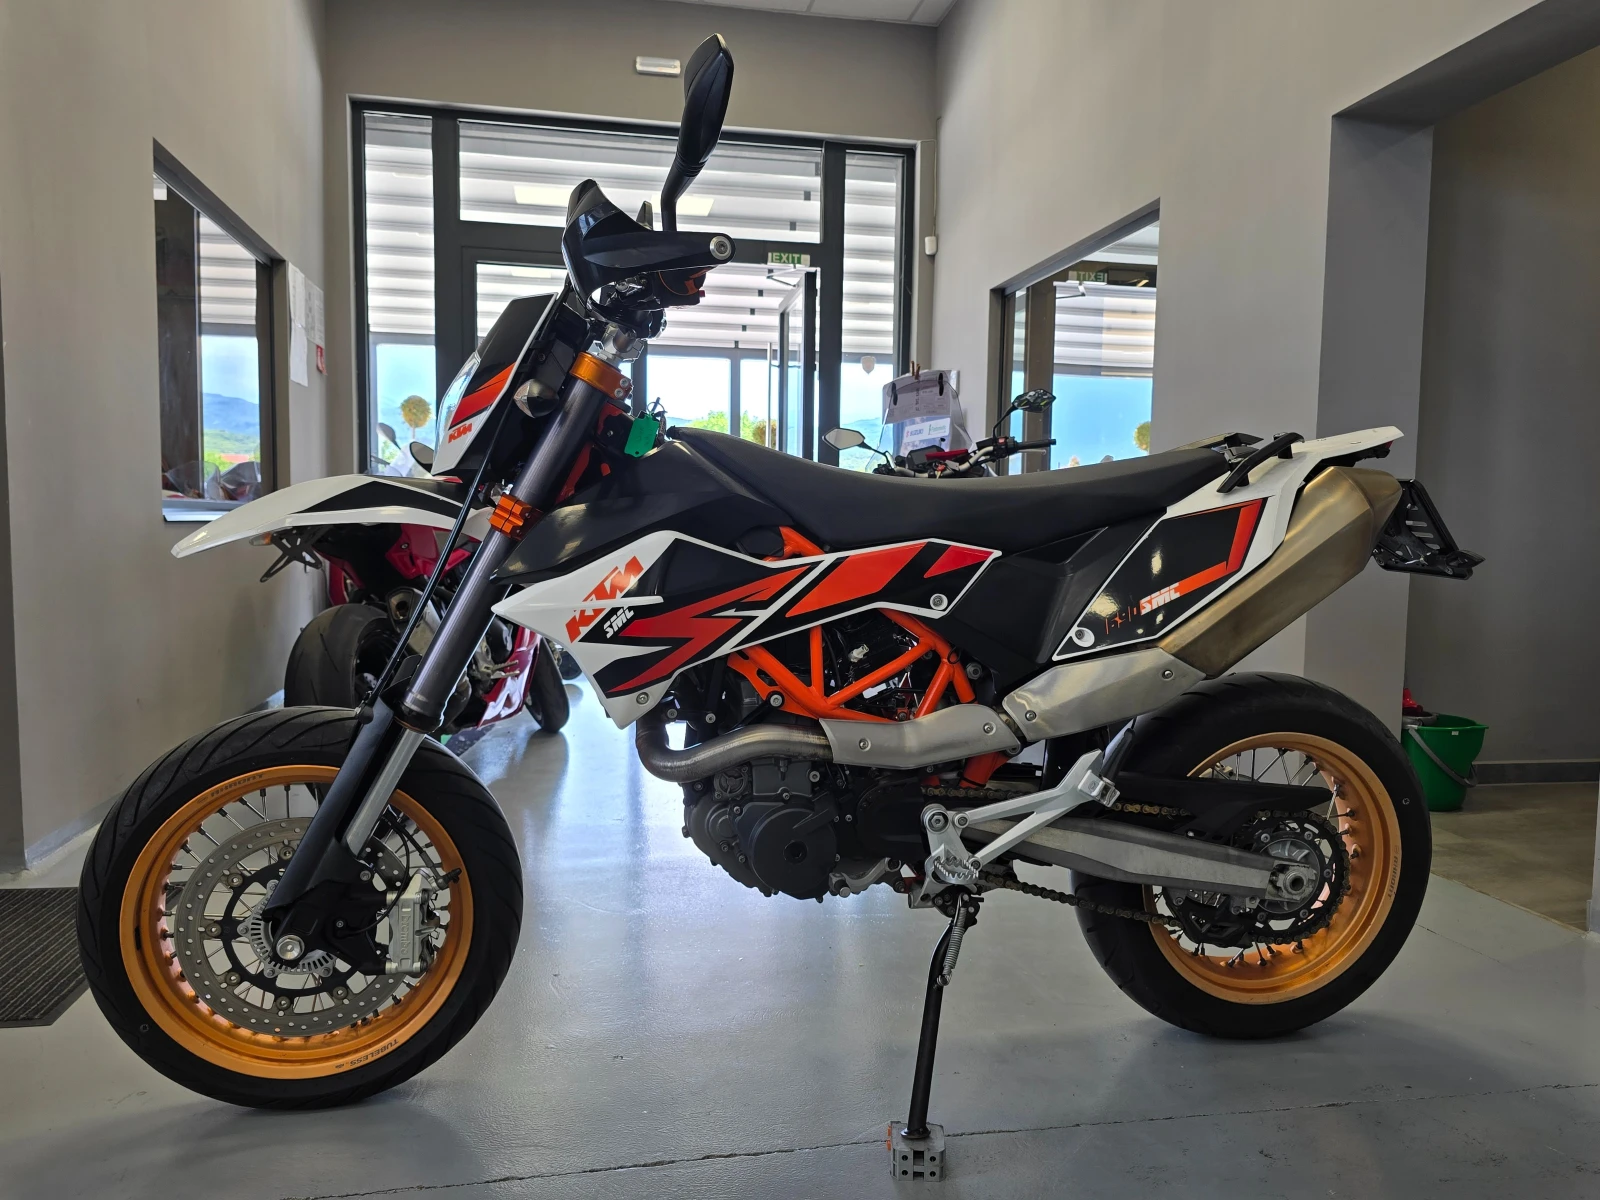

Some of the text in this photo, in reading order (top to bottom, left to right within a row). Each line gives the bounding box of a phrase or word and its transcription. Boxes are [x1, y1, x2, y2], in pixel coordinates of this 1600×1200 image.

[773, 252, 800, 264] EXIT
[448, 422, 473, 444] KTM
[565, 555, 644, 644] KTM
[1140, 581, 1180, 616] SMC
[603, 607, 635, 639] SMC
[349, 1038, 399, 1067] TUBELESS
